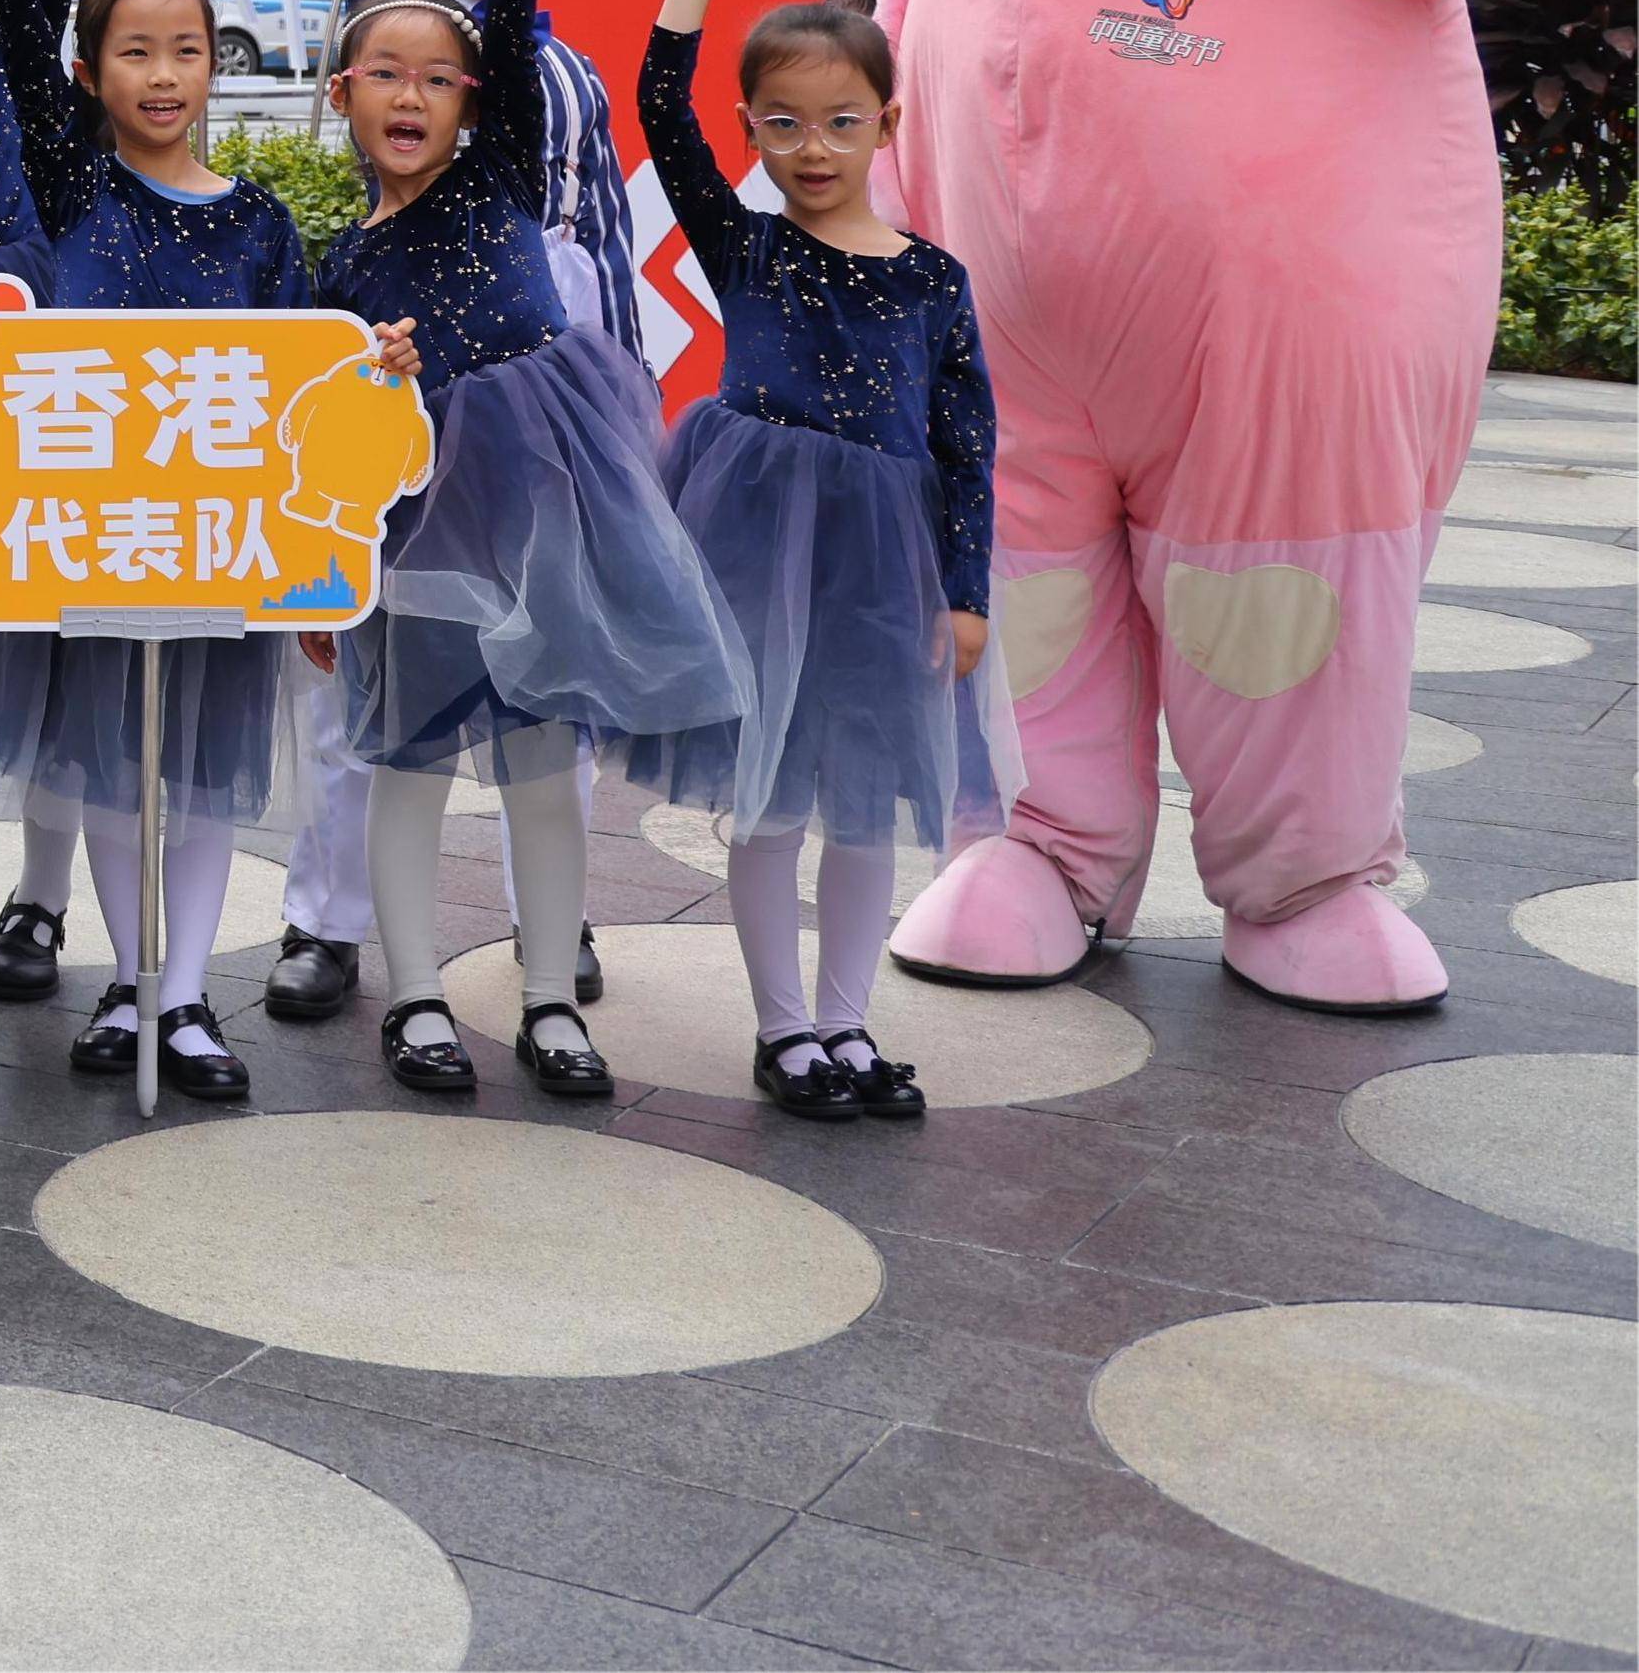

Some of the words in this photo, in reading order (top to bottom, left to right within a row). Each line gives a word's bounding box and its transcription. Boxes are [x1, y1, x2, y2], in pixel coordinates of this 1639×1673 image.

[1088, 17, 1225, 67] 中国童话节
[2, 346, 270, 470] 香港
[0, 498, 280, 582] 代表队
